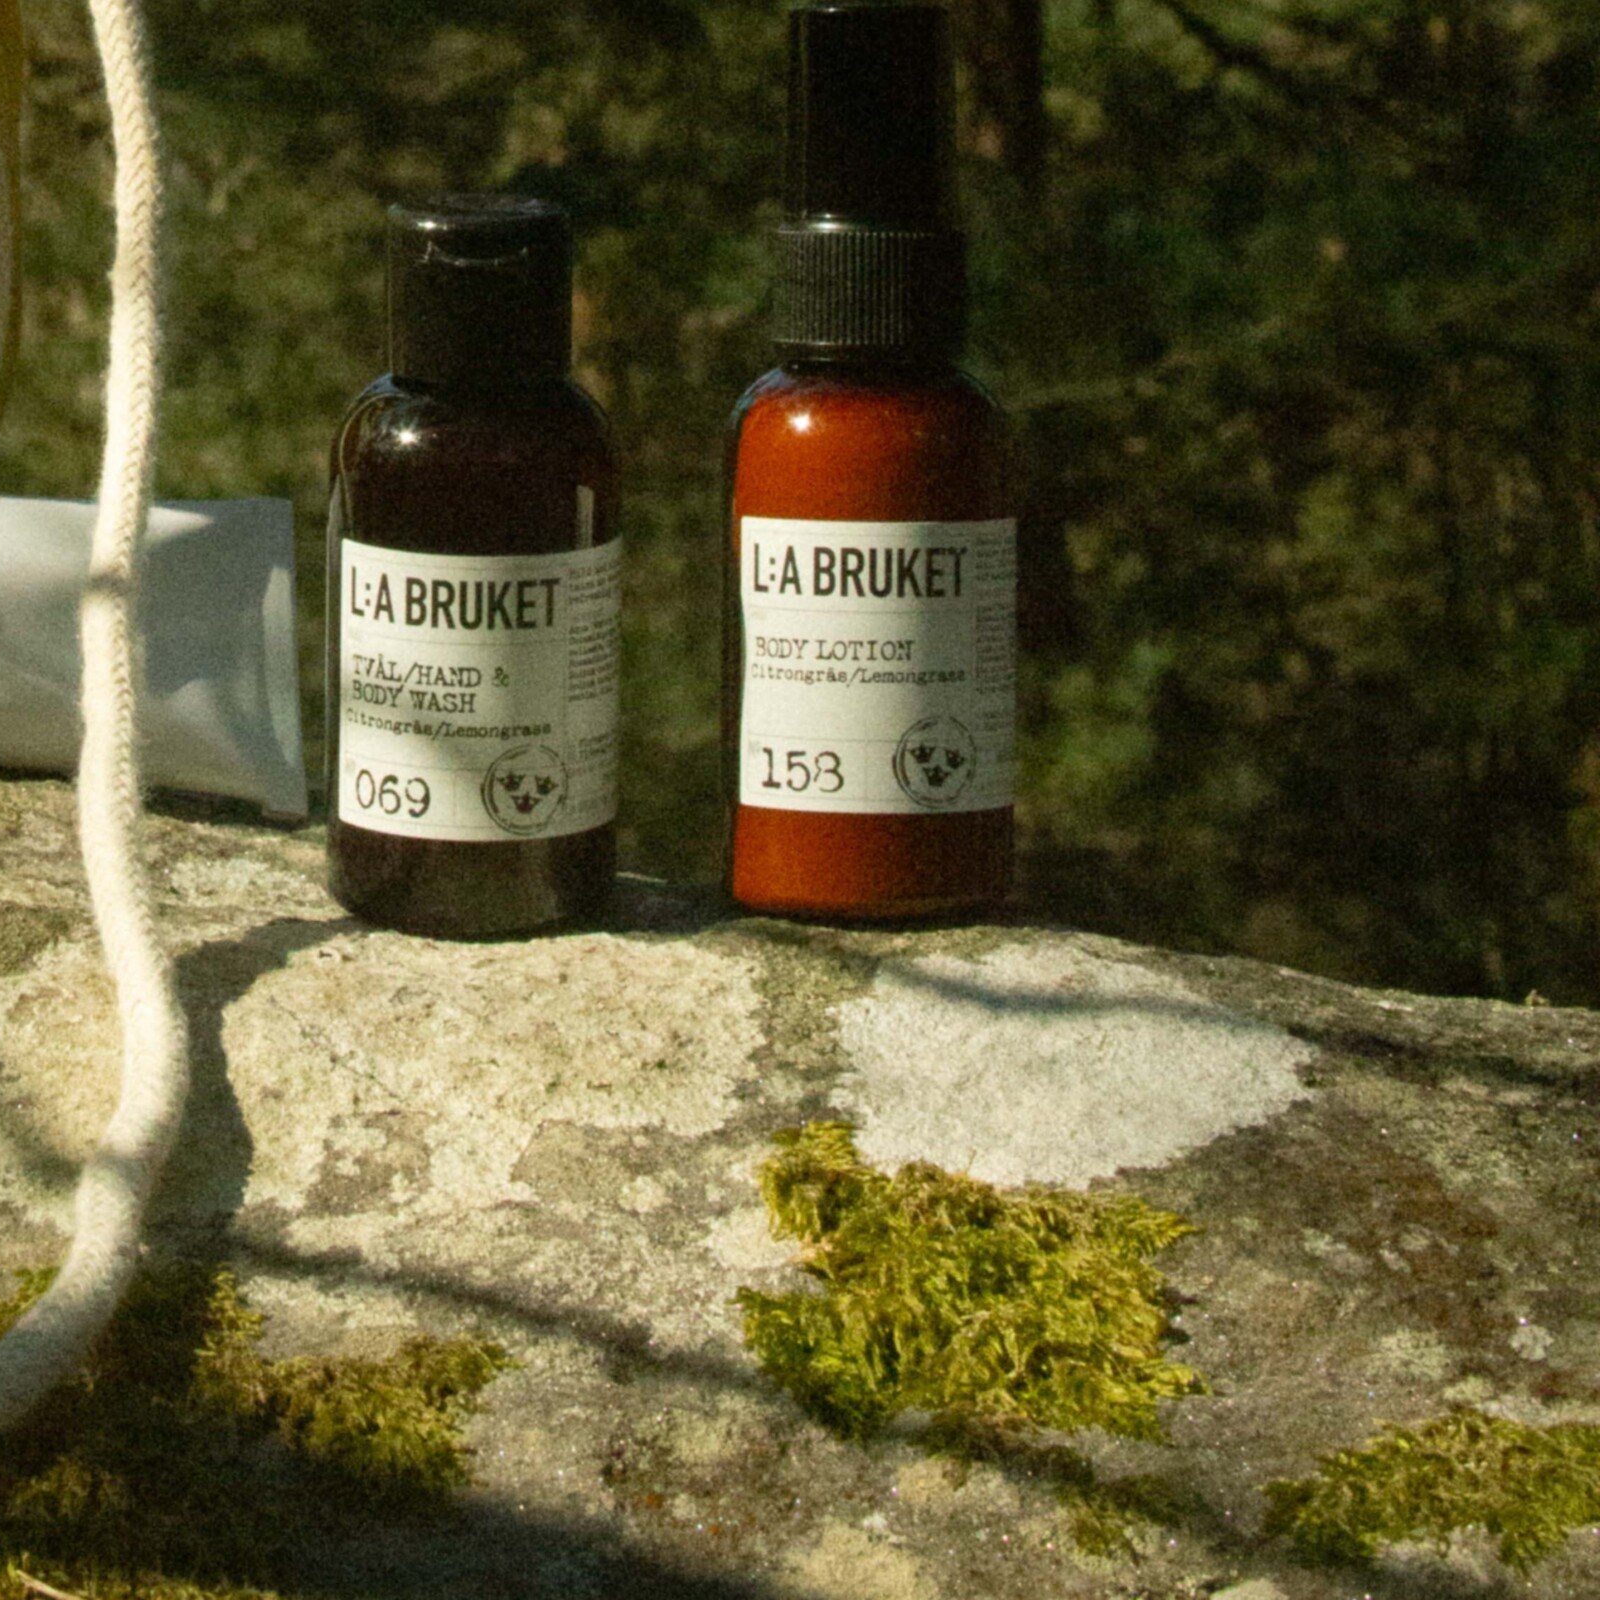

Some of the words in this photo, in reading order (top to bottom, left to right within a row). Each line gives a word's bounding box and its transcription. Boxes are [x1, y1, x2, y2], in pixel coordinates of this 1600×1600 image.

[753, 542, 802, 595] L:A
[813, 546, 967, 598] BRUKET
[351, 566, 395, 623] L:A
[405, 577, 561, 630] BRUKET
[352, 653, 482, 687] TVÅL/HAND
[491, 666, 510, 688] &
[755, 636, 809, 660] BODY
[815, 638, 916, 662] LOTION
[353, 679, 404, 708] BODY
[409, 690, 476, 713] WASH
[762, 747, 845, 793] 158
[355, 768, 431, 819] 069
